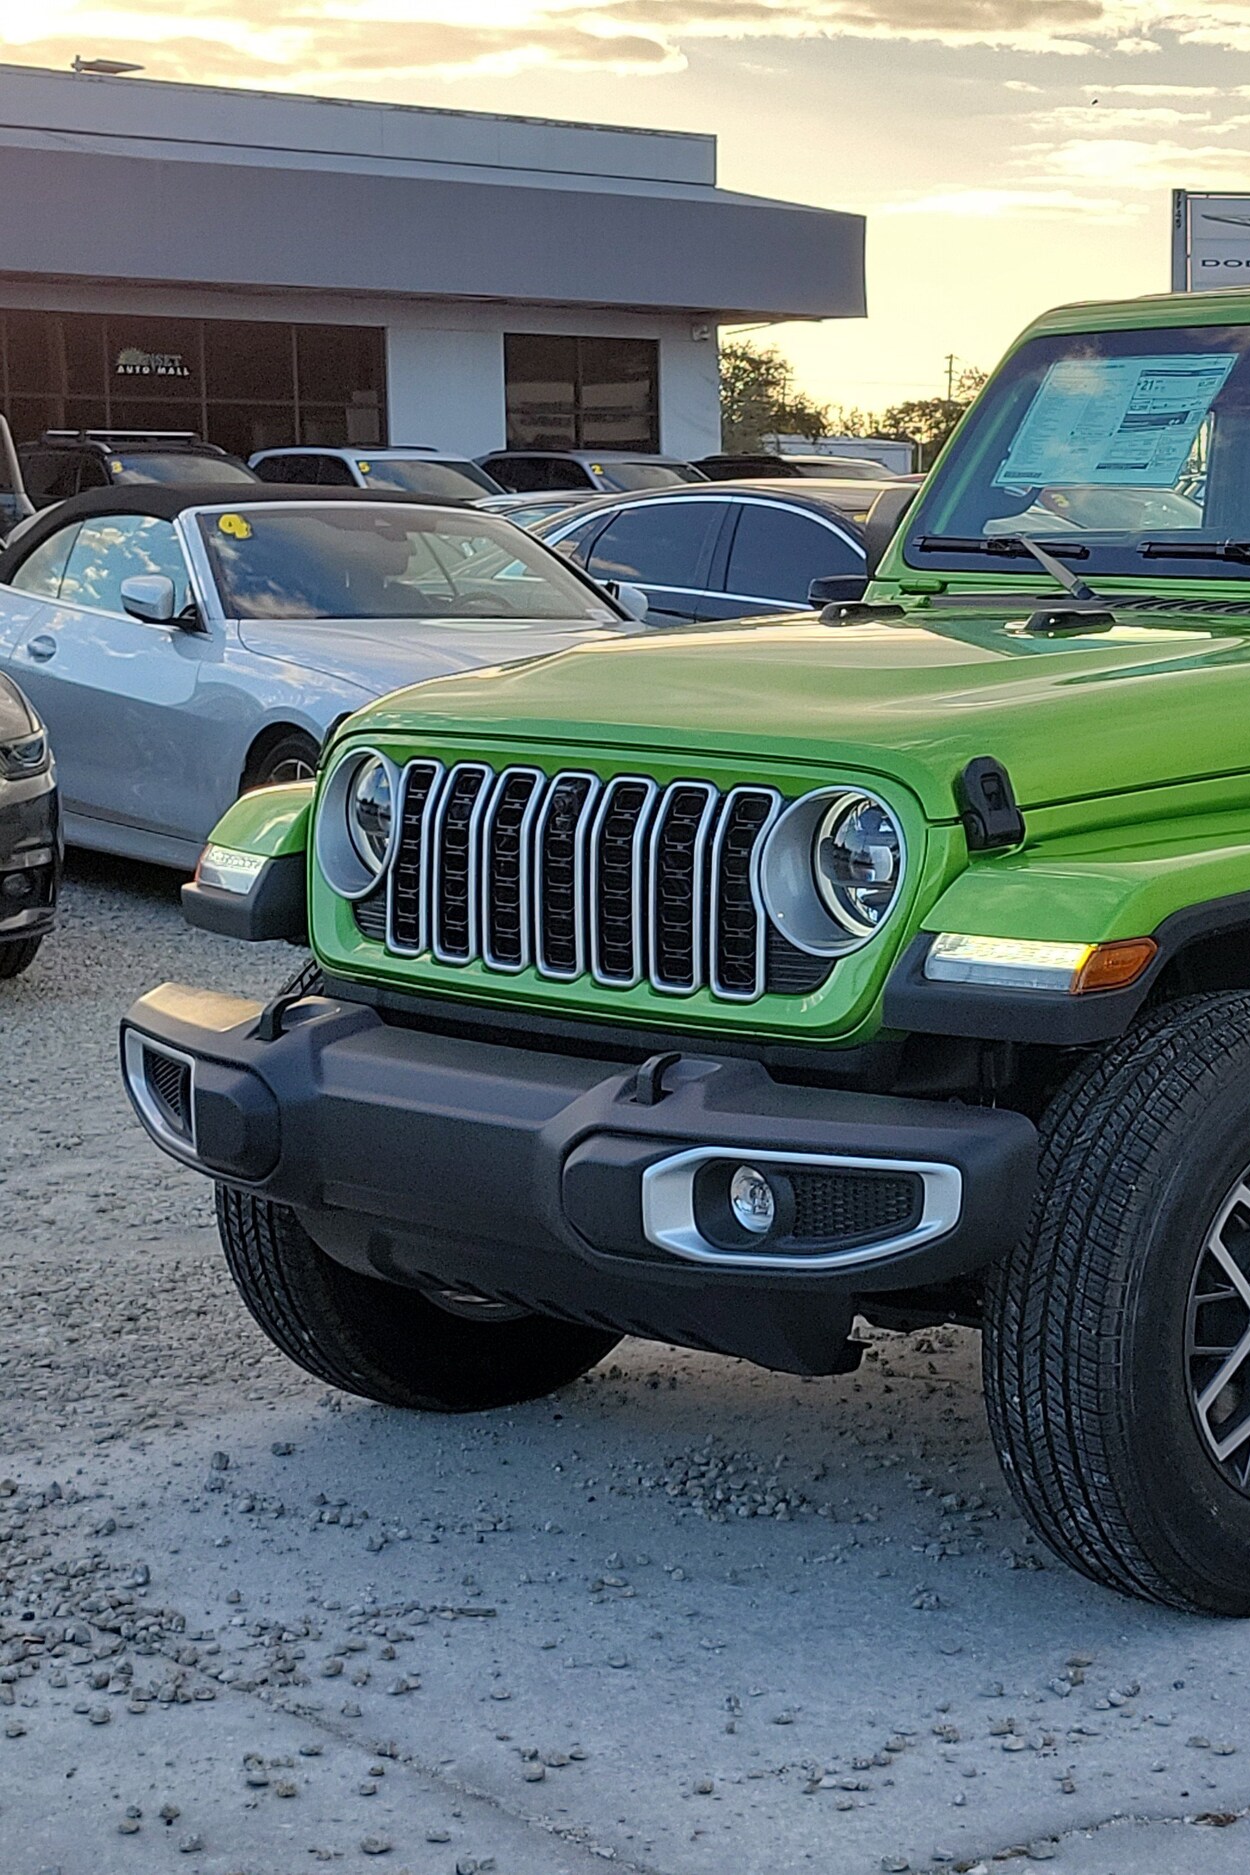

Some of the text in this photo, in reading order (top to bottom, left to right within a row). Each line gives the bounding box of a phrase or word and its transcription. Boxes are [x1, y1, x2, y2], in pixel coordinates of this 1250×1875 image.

[117, 365, 190, 376] AUTO MALL
[1140, 380, 1154, 391] 21
